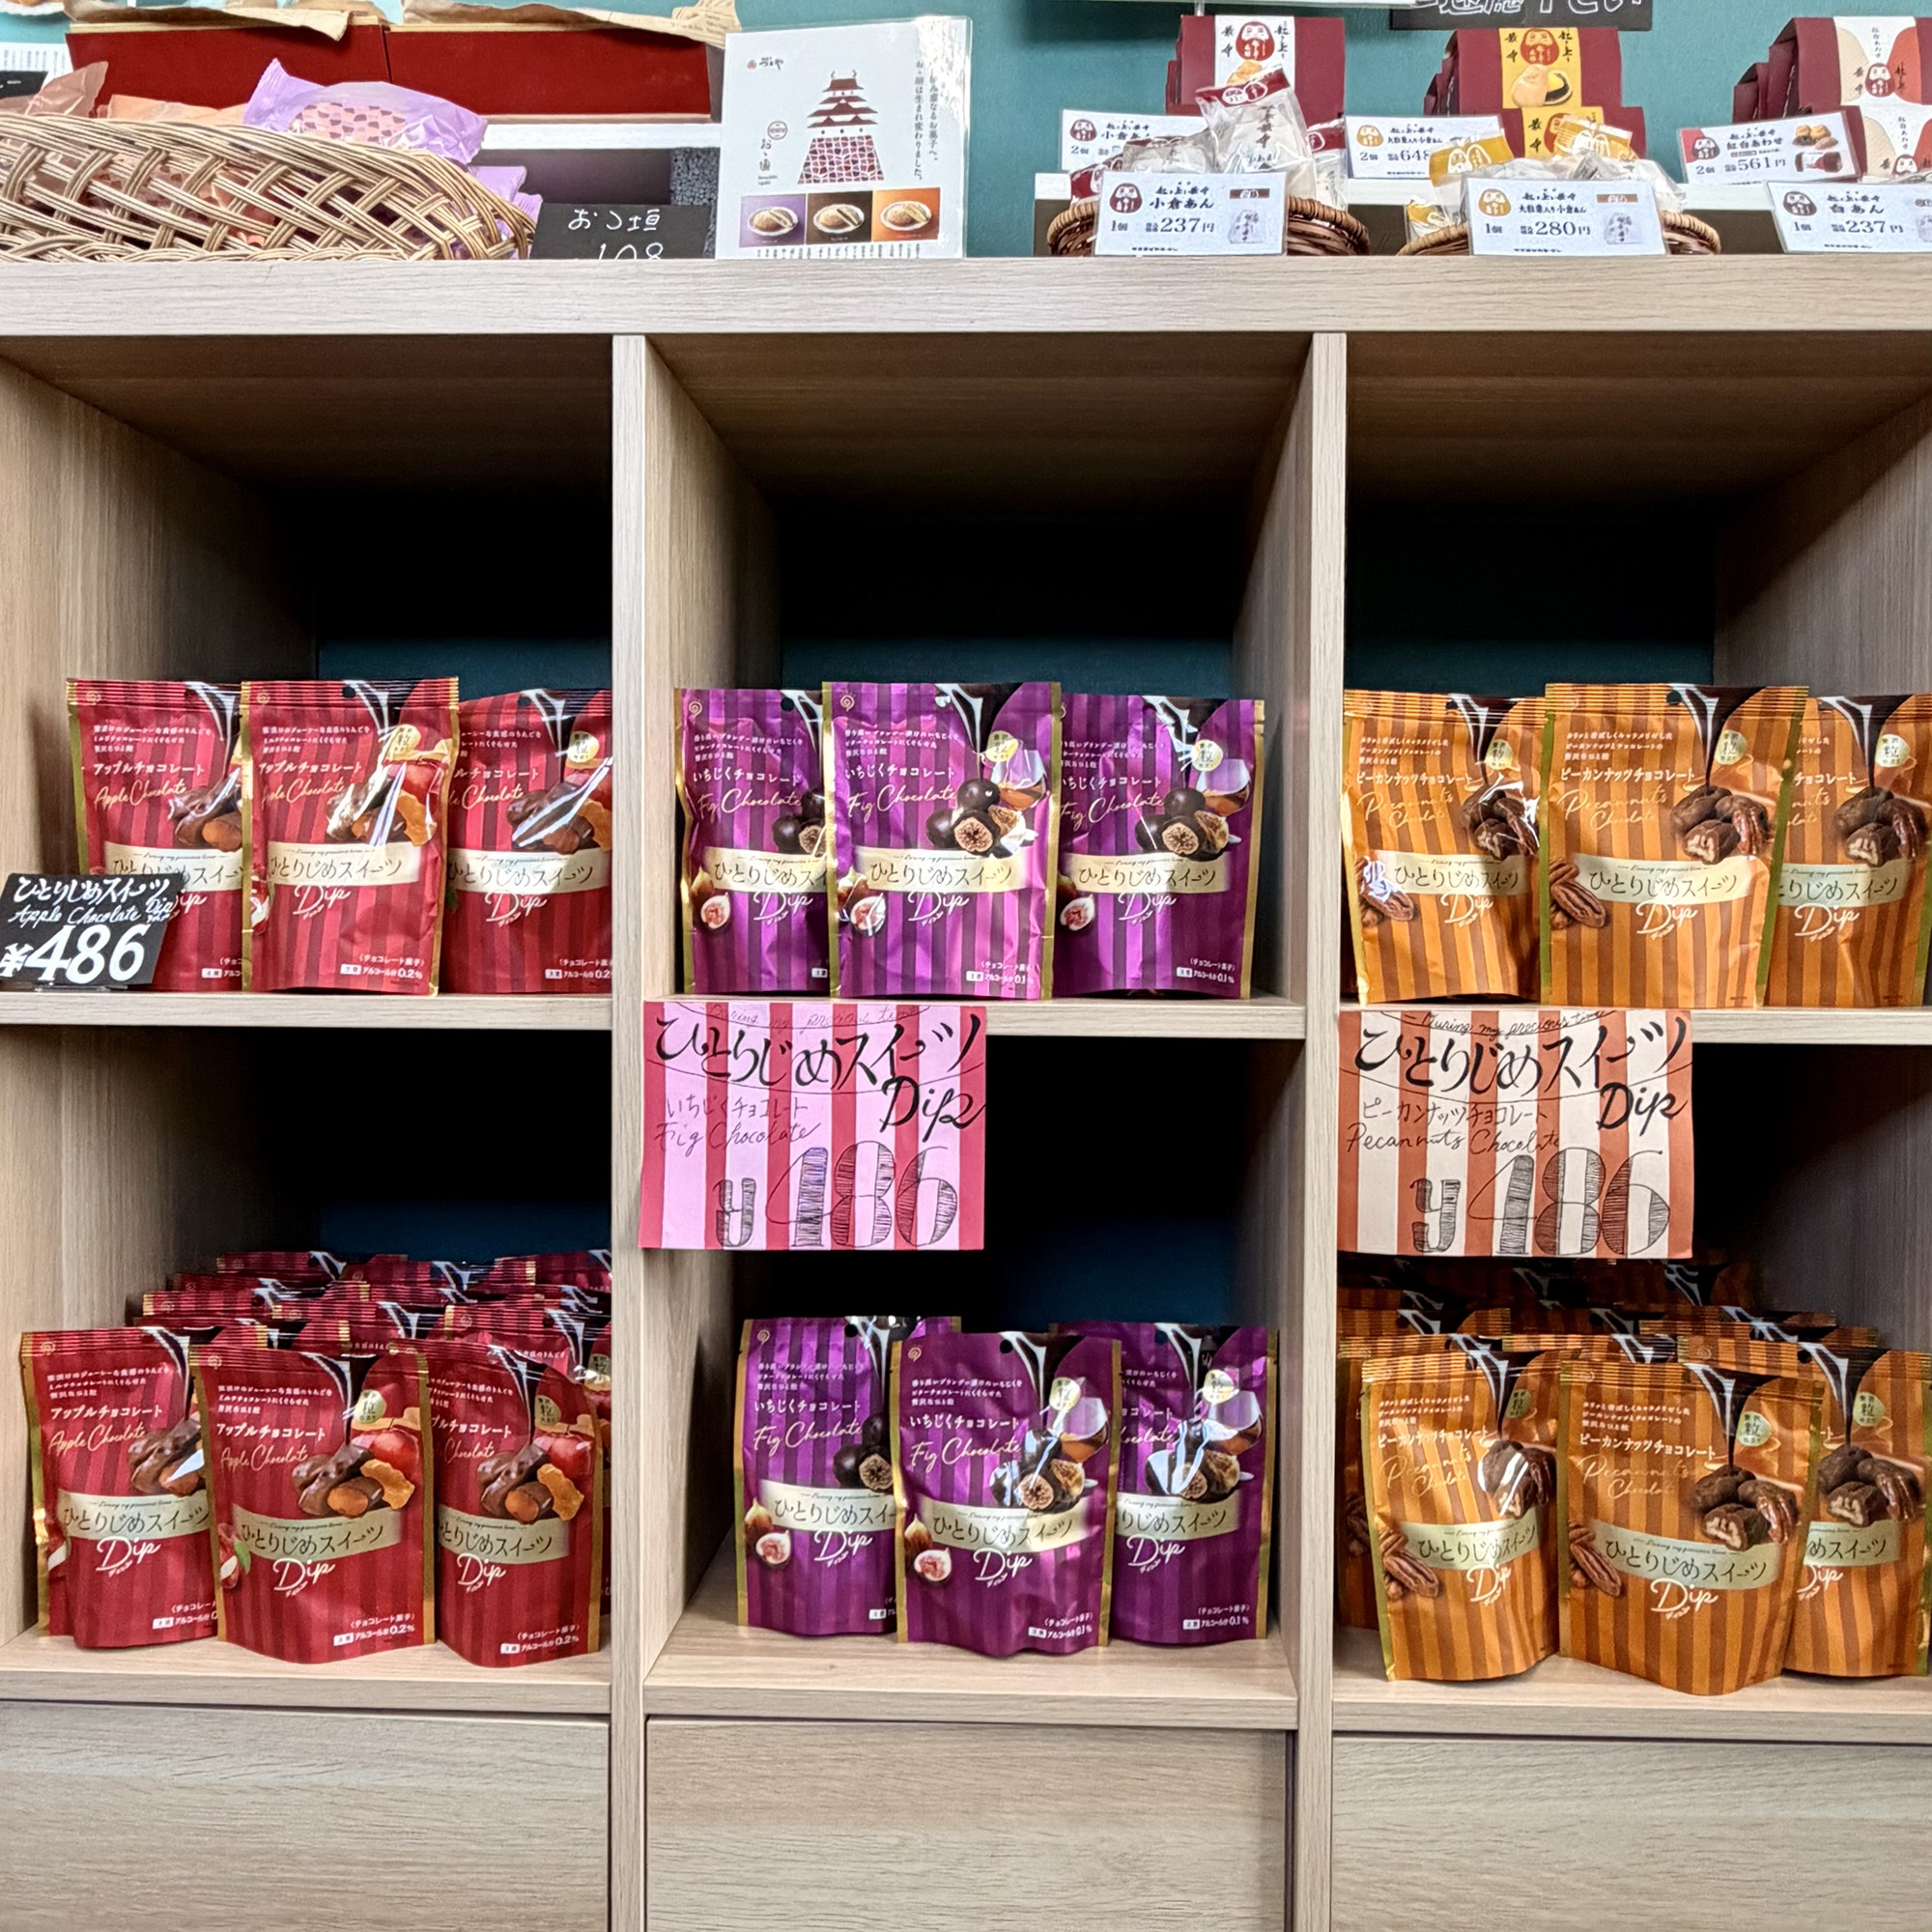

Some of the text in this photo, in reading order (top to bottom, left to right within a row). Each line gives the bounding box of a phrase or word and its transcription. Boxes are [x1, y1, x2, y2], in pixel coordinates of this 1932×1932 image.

[94, 760, 204, 776] アップルチョコレート
[259, 759, 361, 775] アップルチョコレート
[693, 765, 802, 785] いちじくチョコレート
[844, 764, 956, 781] いちじくチョコレート
[1356, 772, 1473, 785] ピーカンナッツチョコレート
[1561, 767, 1694, 782] ピーカンナッツチョコレート
[722, 787, 802, 813] Chocolate
[847, 783, 957, 822] Fig Chocolate
[1089, 792, 1165, 824] Chocolate
[14, 876, 170, 905] ひとりじめスイーツ
[870, 863, 1012, 887] ひとりじめスイーツ
[1078, 867, 1216, 887] ひとりじめスイーツ
[1394, 866, 1519, 889] ひとりじめスイーツ
[1589, 871, 1737, 898] ひとりじめスイーツ
[8, 904, 142, 928] Apple Chocolate
[175, 890, 208, 914] ip
[293, 885, 352, 916] Dip
[485, 892, 548, 922] Dip
[753, 891, 813, 922] Dip
[908, 891, 969, 922] Dip
[1119, 891, 1178, 922] Dip
[1440, 894, 1493, 924] Dip
[1635, 899, 1698, 935] Dip
[1794, 902, 1860, 937] Dip
[0, 923, 152, 984] ¥486
[656, 1013, 981, 1092] ひとりじめスイーツ
[1354, 1016, 1687, 1097] ひとりじめスイーツ
[667, 1094, 808, 1120] いちじくチョコレート
[879, 1075, 986, 1143] Dip
[1363, 1097, 1548, 1128] ピーカンナッツチョコレート
[1596, 1082, 1689, 1137] Dip
[654, 1121, 821, 1158] Fig Chocolate
[1469, 1129, 1560, 1154] Chocolate
[50, 1405, 162, 1420] アップルチョコレート
[753, 1399, 861, 1413] いちじくチョコレート
[910, 1412, 1018, 1429] いちじくチョコレート
[88, 1421, 146, 1452] Chocolate
[216, 1422, 326, 1441] アップルチョコレート
[753, 1420, 863, 1458] Fig Chocolate
[1579, 1433, 1716, 1460] ピーカンナッツチョコレート
[250, 1444, 308, 1472] Chocolate
[910, 1436, 1022, 1473] Fig Chocolate
[242, 1523, 384, 1555] ひとりじめスイーツ
[813, 1528, 873, 1561] Dip
[933, 1517, 1073, 1547] ひとりじめスイーツ
[96, 1535, 161, 1571] Dip
[973, 1547, 1033, 1581] Dip
[1126, 1534, 1186, 1567] Dip
[1605, 1540, 1767, 1583] ひとりじめスイーツ
[1807, 1539, 1887, 1560] めスイーツ
[272, 1558, 335, 1592] Dip
[456, 1552, 506, 1587] Dip
[1466, 1563, 1512, 1603] Dip
[1650, 1577, 1719, 1613] Dip
